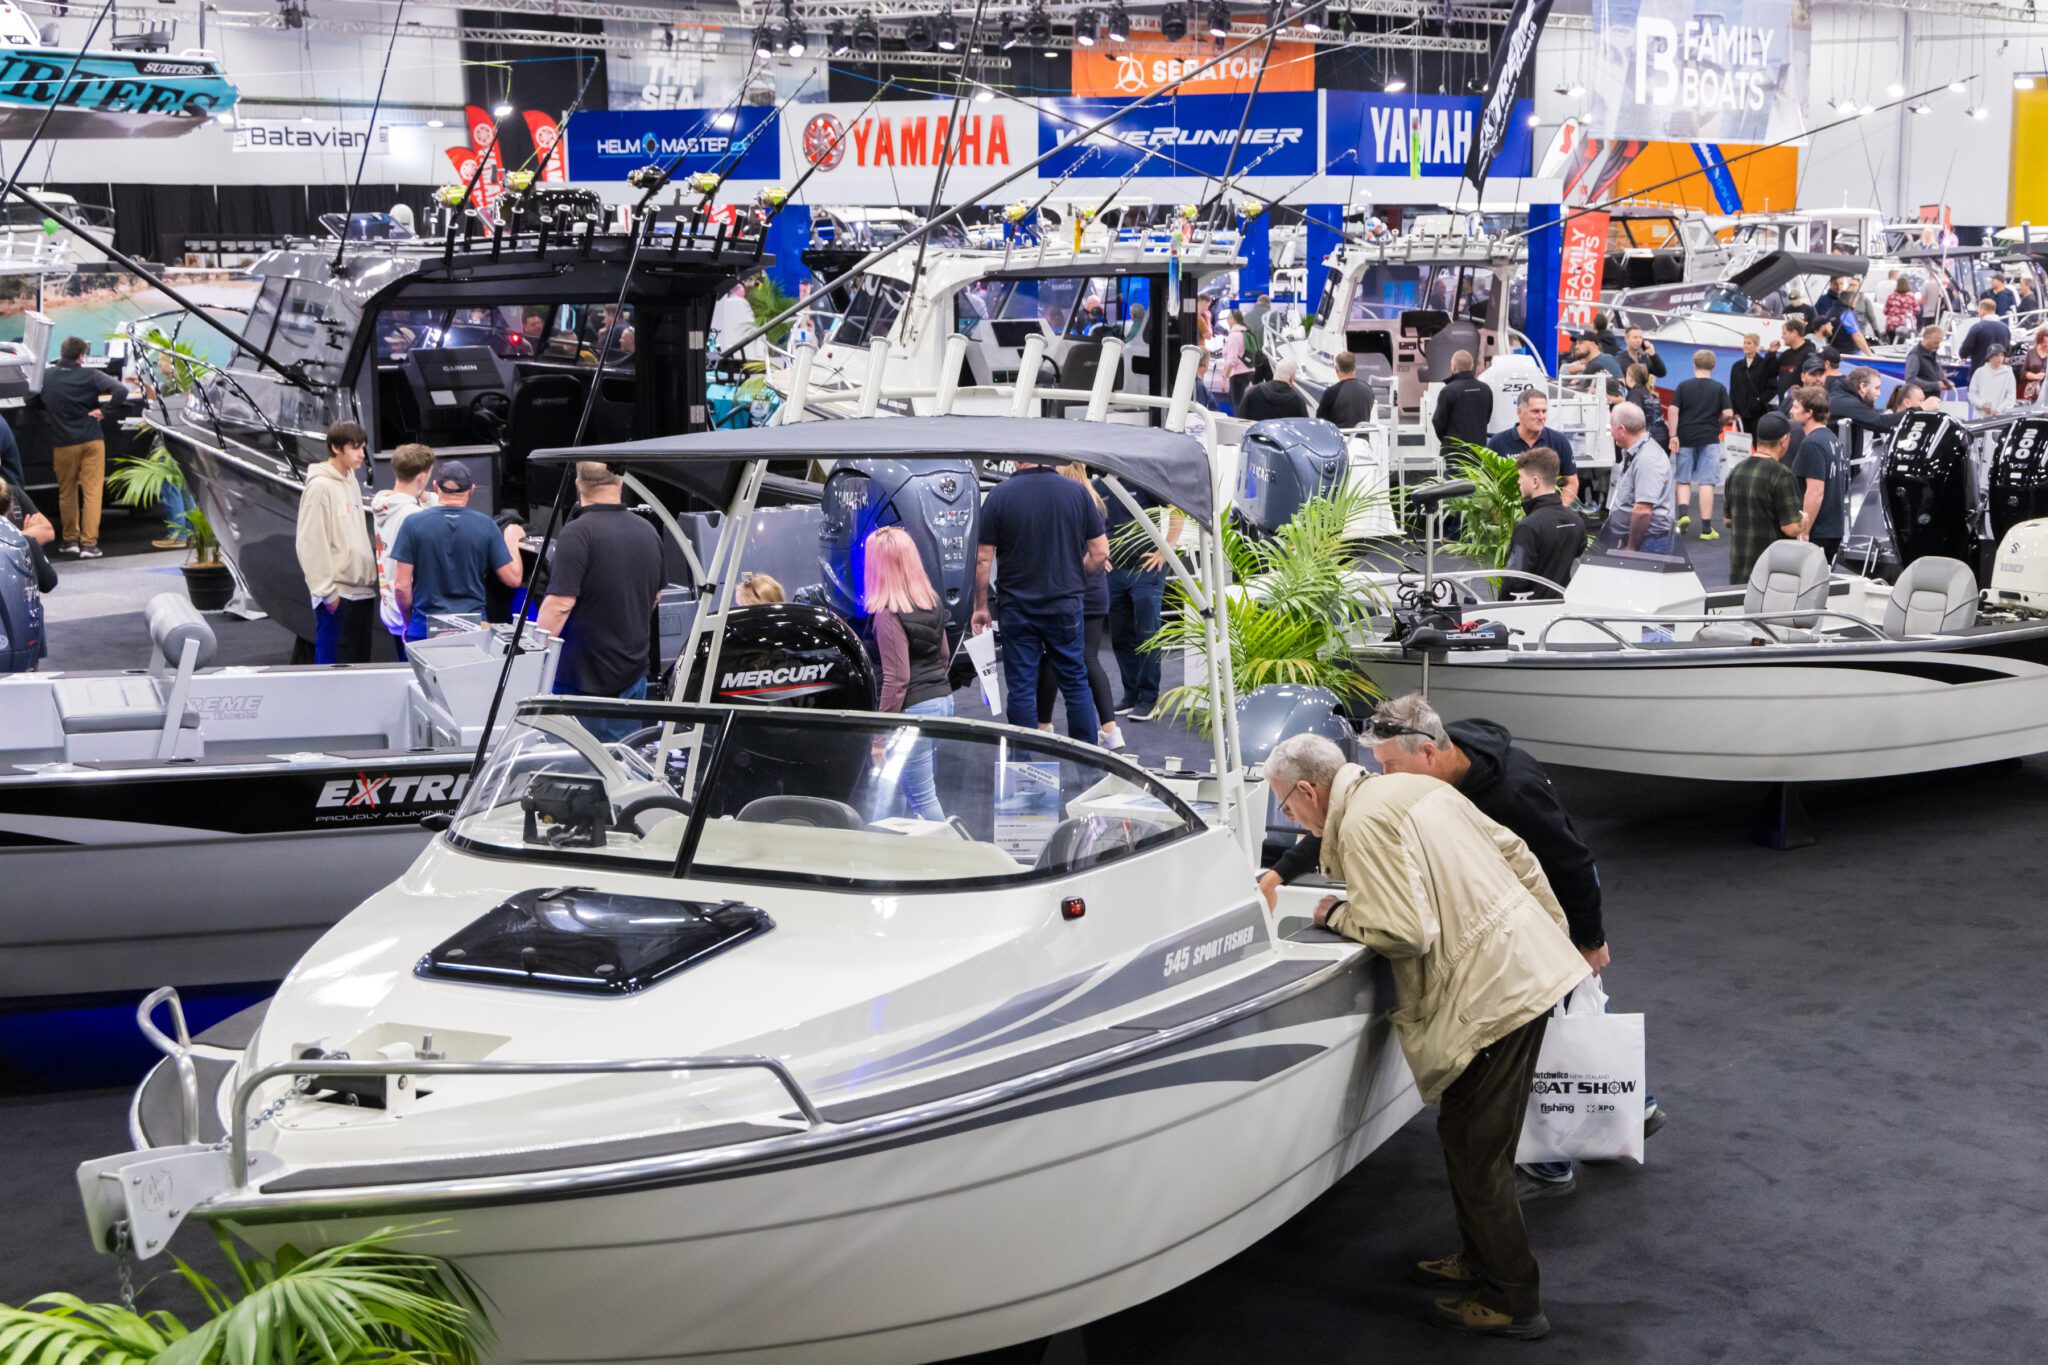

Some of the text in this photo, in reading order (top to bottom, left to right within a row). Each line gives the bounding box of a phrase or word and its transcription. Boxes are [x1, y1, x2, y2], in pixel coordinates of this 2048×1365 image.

[1683, 20, 1774, 67] FAMILY
[143, 62, 205, 75] SURTEES
[1153, 57, 1264, 83] SENATOR
[641, 84, 696, 109] SEA
[1682, 67, 1765, 112] BOATS
[251, 126, 368, 147] Batavian
[597, 139, 641, 154] HELM
[661, 137, 730, 153] MASTER
[851, 114, 1010, 167] YAMAHA
[1370, 107, 1473, 164] YAMAH
[1564, 227, 1587, 301] FAMILY
[1579, 235, 1601, 302] BOATS
[1502, 383, 1535, 393] 250
[2015, 428, 2039, 460] 200
[720, 662, 835, 689] MERCURY
[315, 813, 382, 822] PROUDLY
[1163, 925, 1255, 977] 545 SPORT FISHER
[1531, 1080, 1637, 1095] OAT SHOW
[1540, 1102, 1575, 1114] fishing
